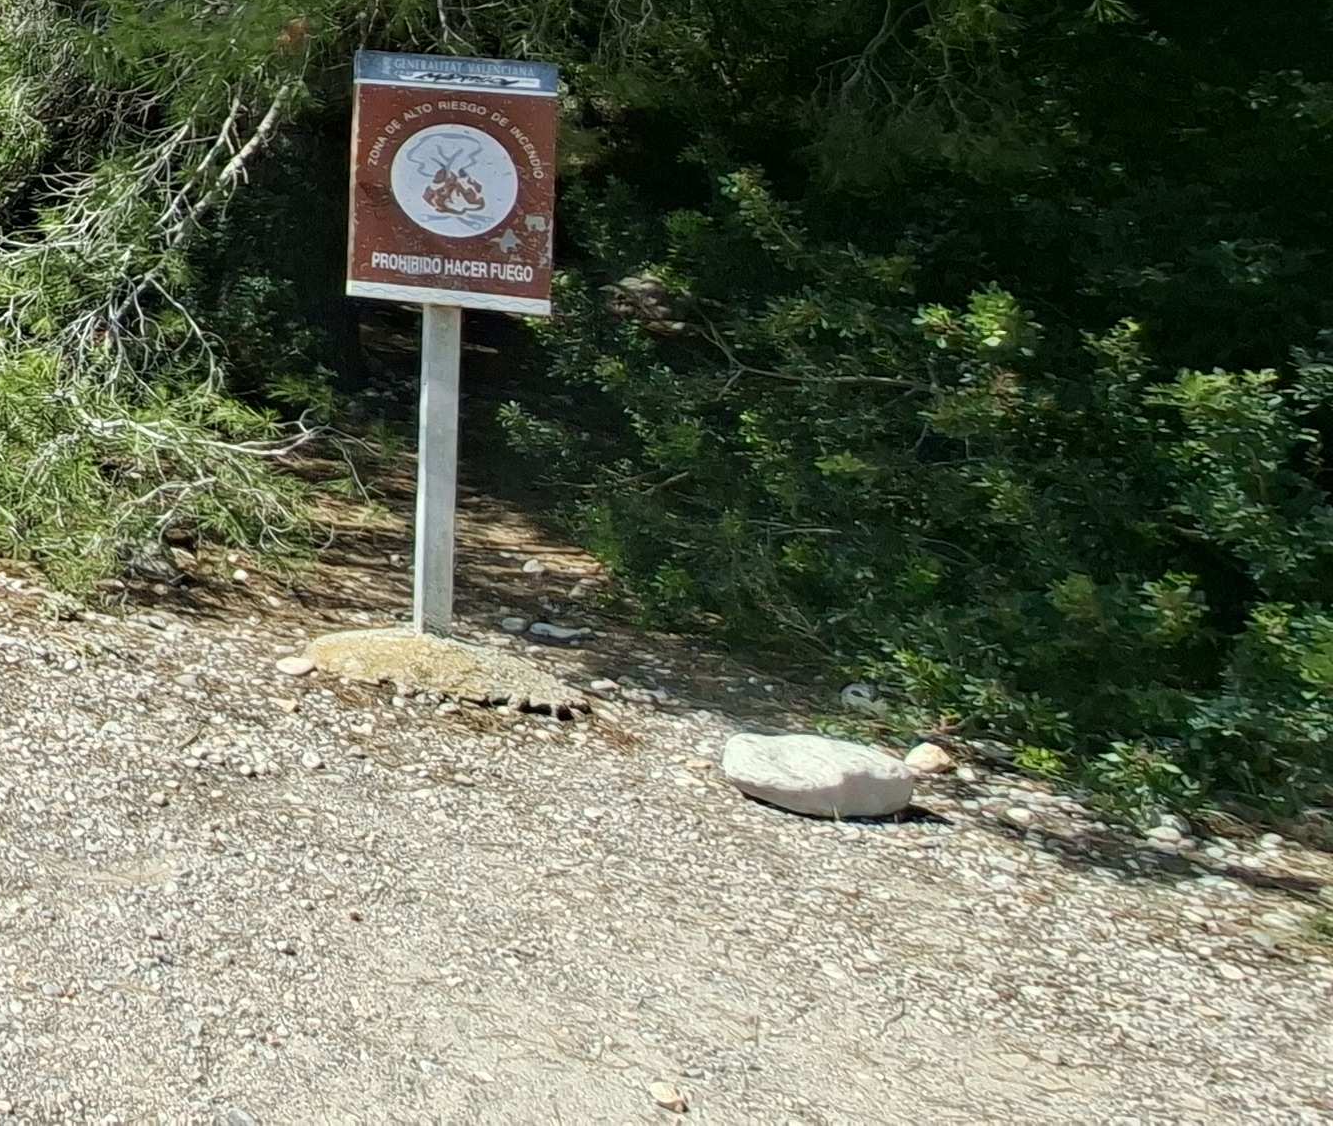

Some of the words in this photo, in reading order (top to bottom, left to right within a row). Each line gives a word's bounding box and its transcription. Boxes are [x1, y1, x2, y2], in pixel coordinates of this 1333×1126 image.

[394, 58, 463, 73] GENERALITAT
[467, 62, 534, 77] VALENCIANA
[367, 136, 388, 166] ZONA
[384, 119, 402, 135] DE
[403, 103, 433, 121] ALTO
[438, 101, 487, 115] RIESGO
[491, 112, 509, 126] DE
[509, 126, 544, 180] INCENDIO
[371, 251, 441, 275] PROHIBIDO
[444, 258, 488, 278] HACER
[490, 263, 533, 282] FUEGO
